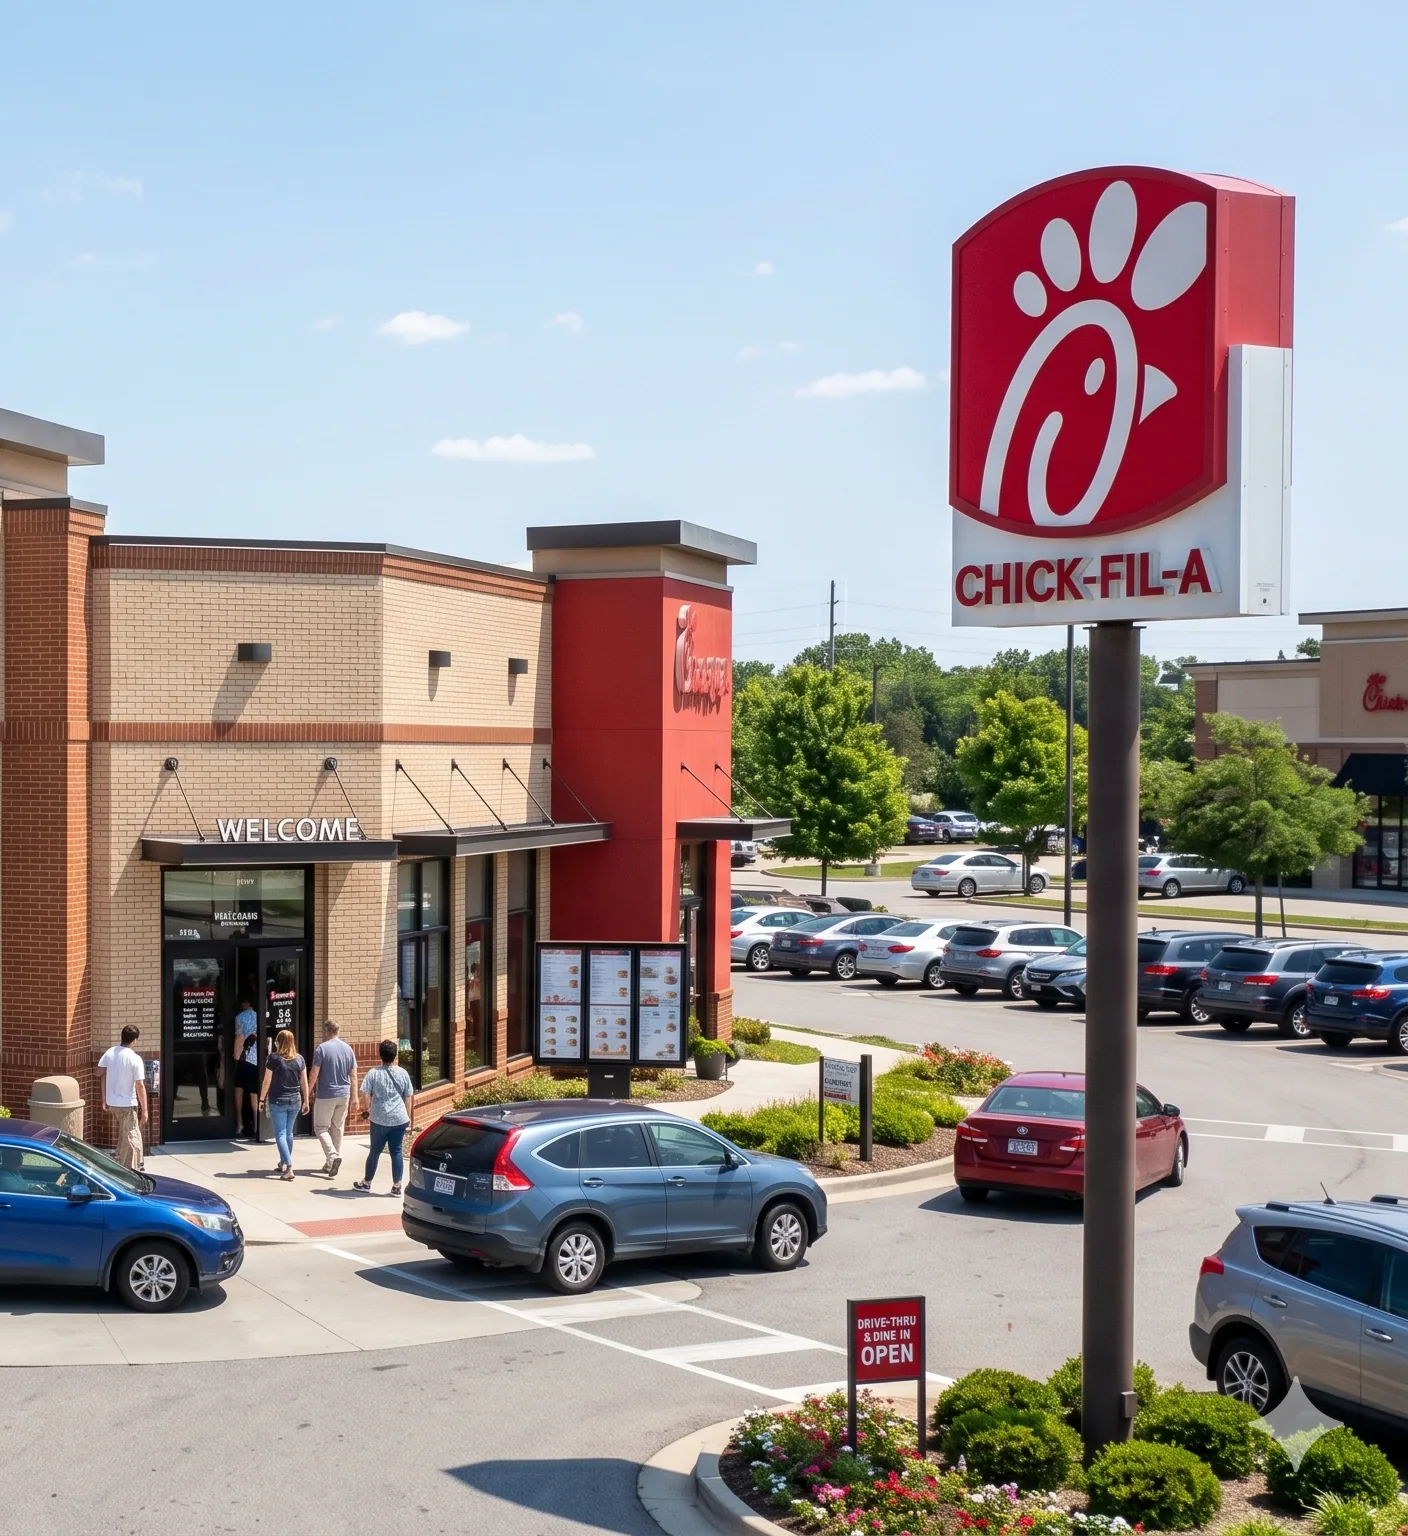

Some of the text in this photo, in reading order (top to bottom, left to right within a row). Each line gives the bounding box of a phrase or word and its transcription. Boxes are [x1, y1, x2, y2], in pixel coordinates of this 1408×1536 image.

[955, 548, 1213, 607] CHICK-FIL-A
[216, 817, 362, 842] WELCOME
[857, 1315, 917, 1330] DRIVE-THRU
[863, 1329, 911, 1342] & DINE IN
[861, 1343, 914, 1366] OPEN
